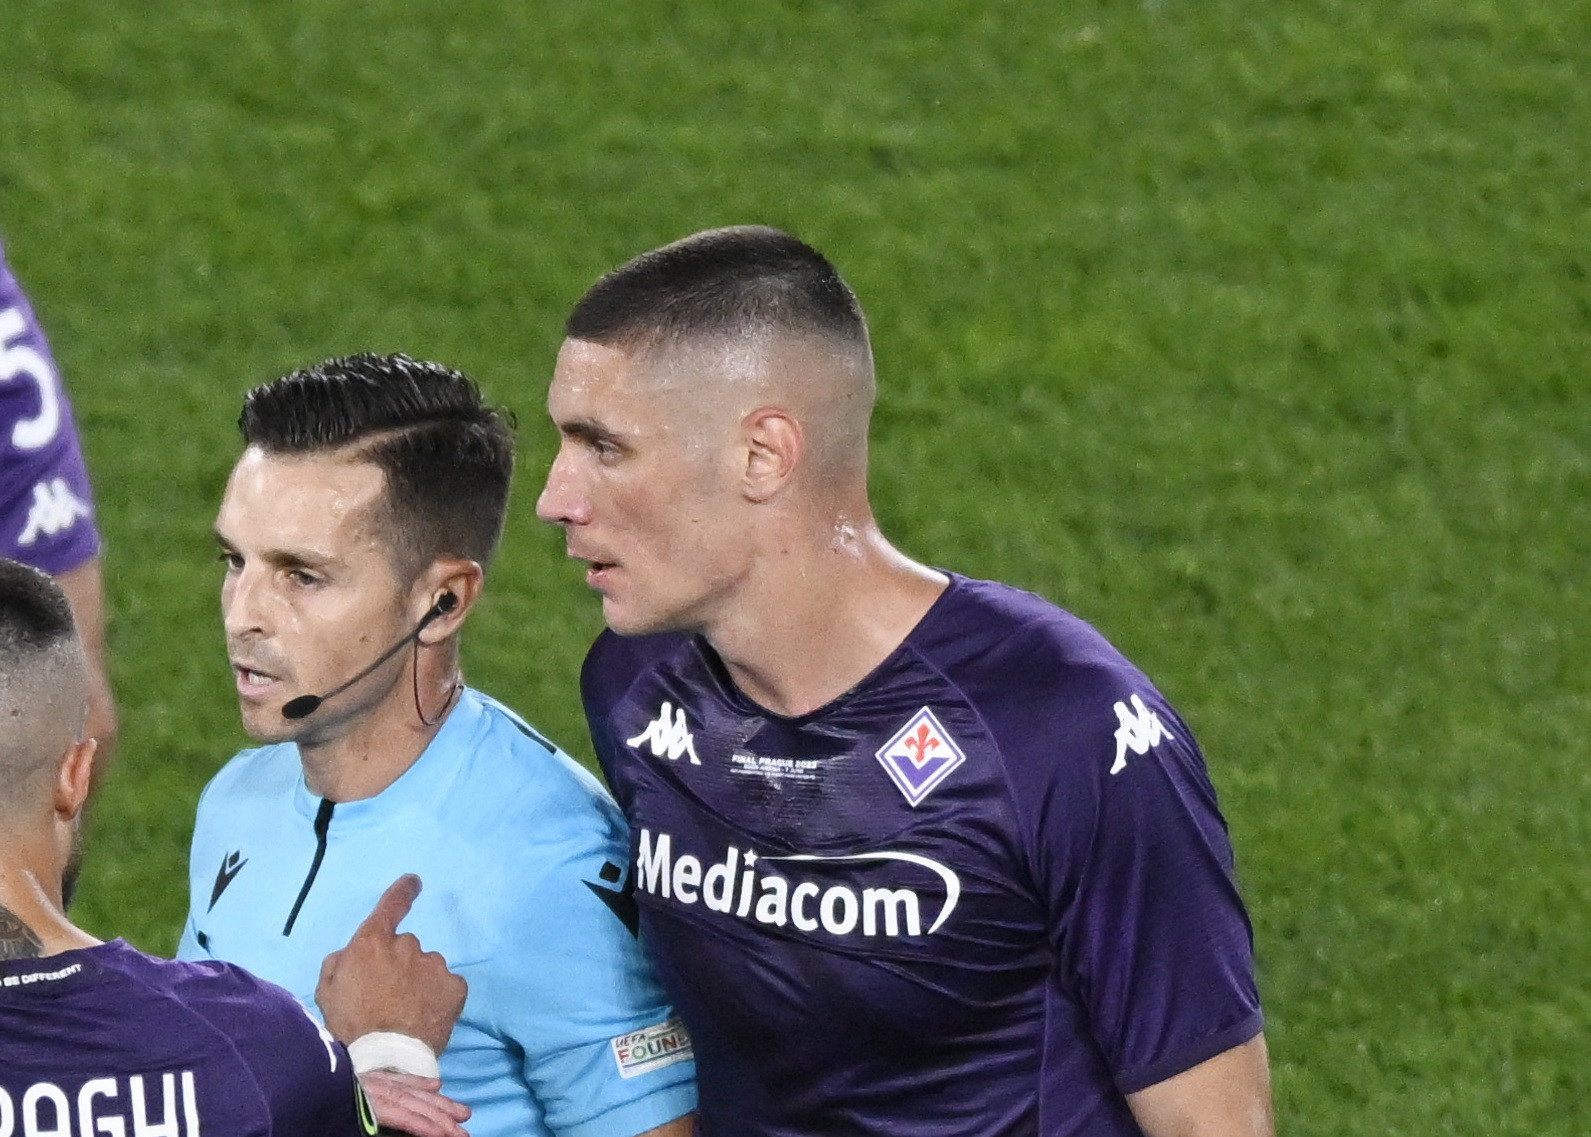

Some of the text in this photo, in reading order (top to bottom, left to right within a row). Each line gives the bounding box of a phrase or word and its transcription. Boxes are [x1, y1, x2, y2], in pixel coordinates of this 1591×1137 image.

[731, 754, 757, 765] FINAL
[758, 757, 794, 768] PRAGUE
[636, 828, 922, 938] Mediacom
[3, 976, 20, 987] BE
[20, 963, 82, 985] DIFFERENT
[616, 1034, 646, 1048] UEFA
